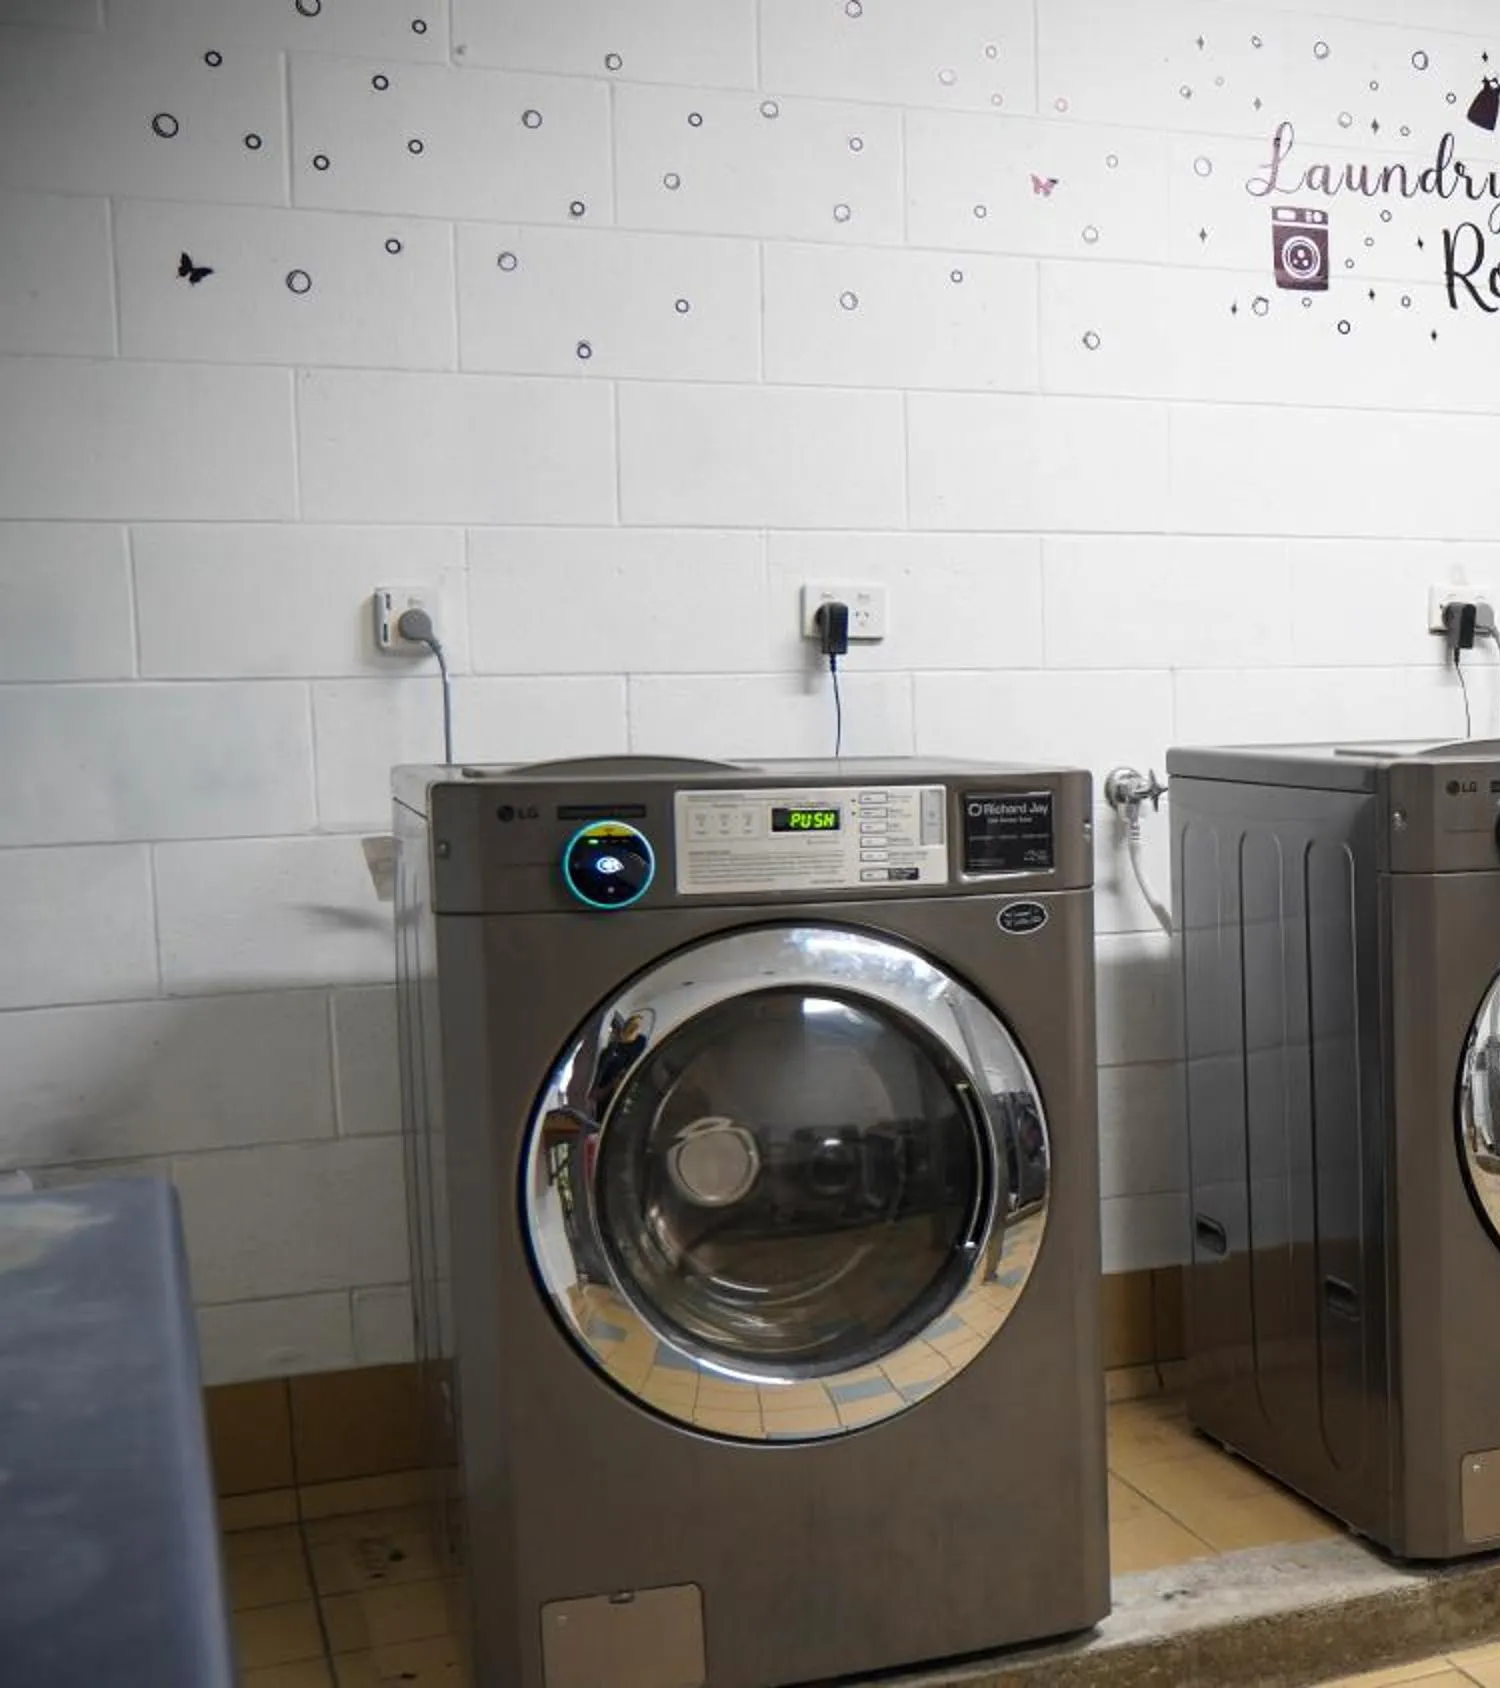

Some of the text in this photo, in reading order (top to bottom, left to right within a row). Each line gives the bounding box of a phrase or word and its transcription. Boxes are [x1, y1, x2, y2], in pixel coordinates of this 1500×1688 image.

[517, 805, 539, 819] LG
[983, 802, 1048, 816] Richard Jay
[789, 812, 836, 829] PUSH
